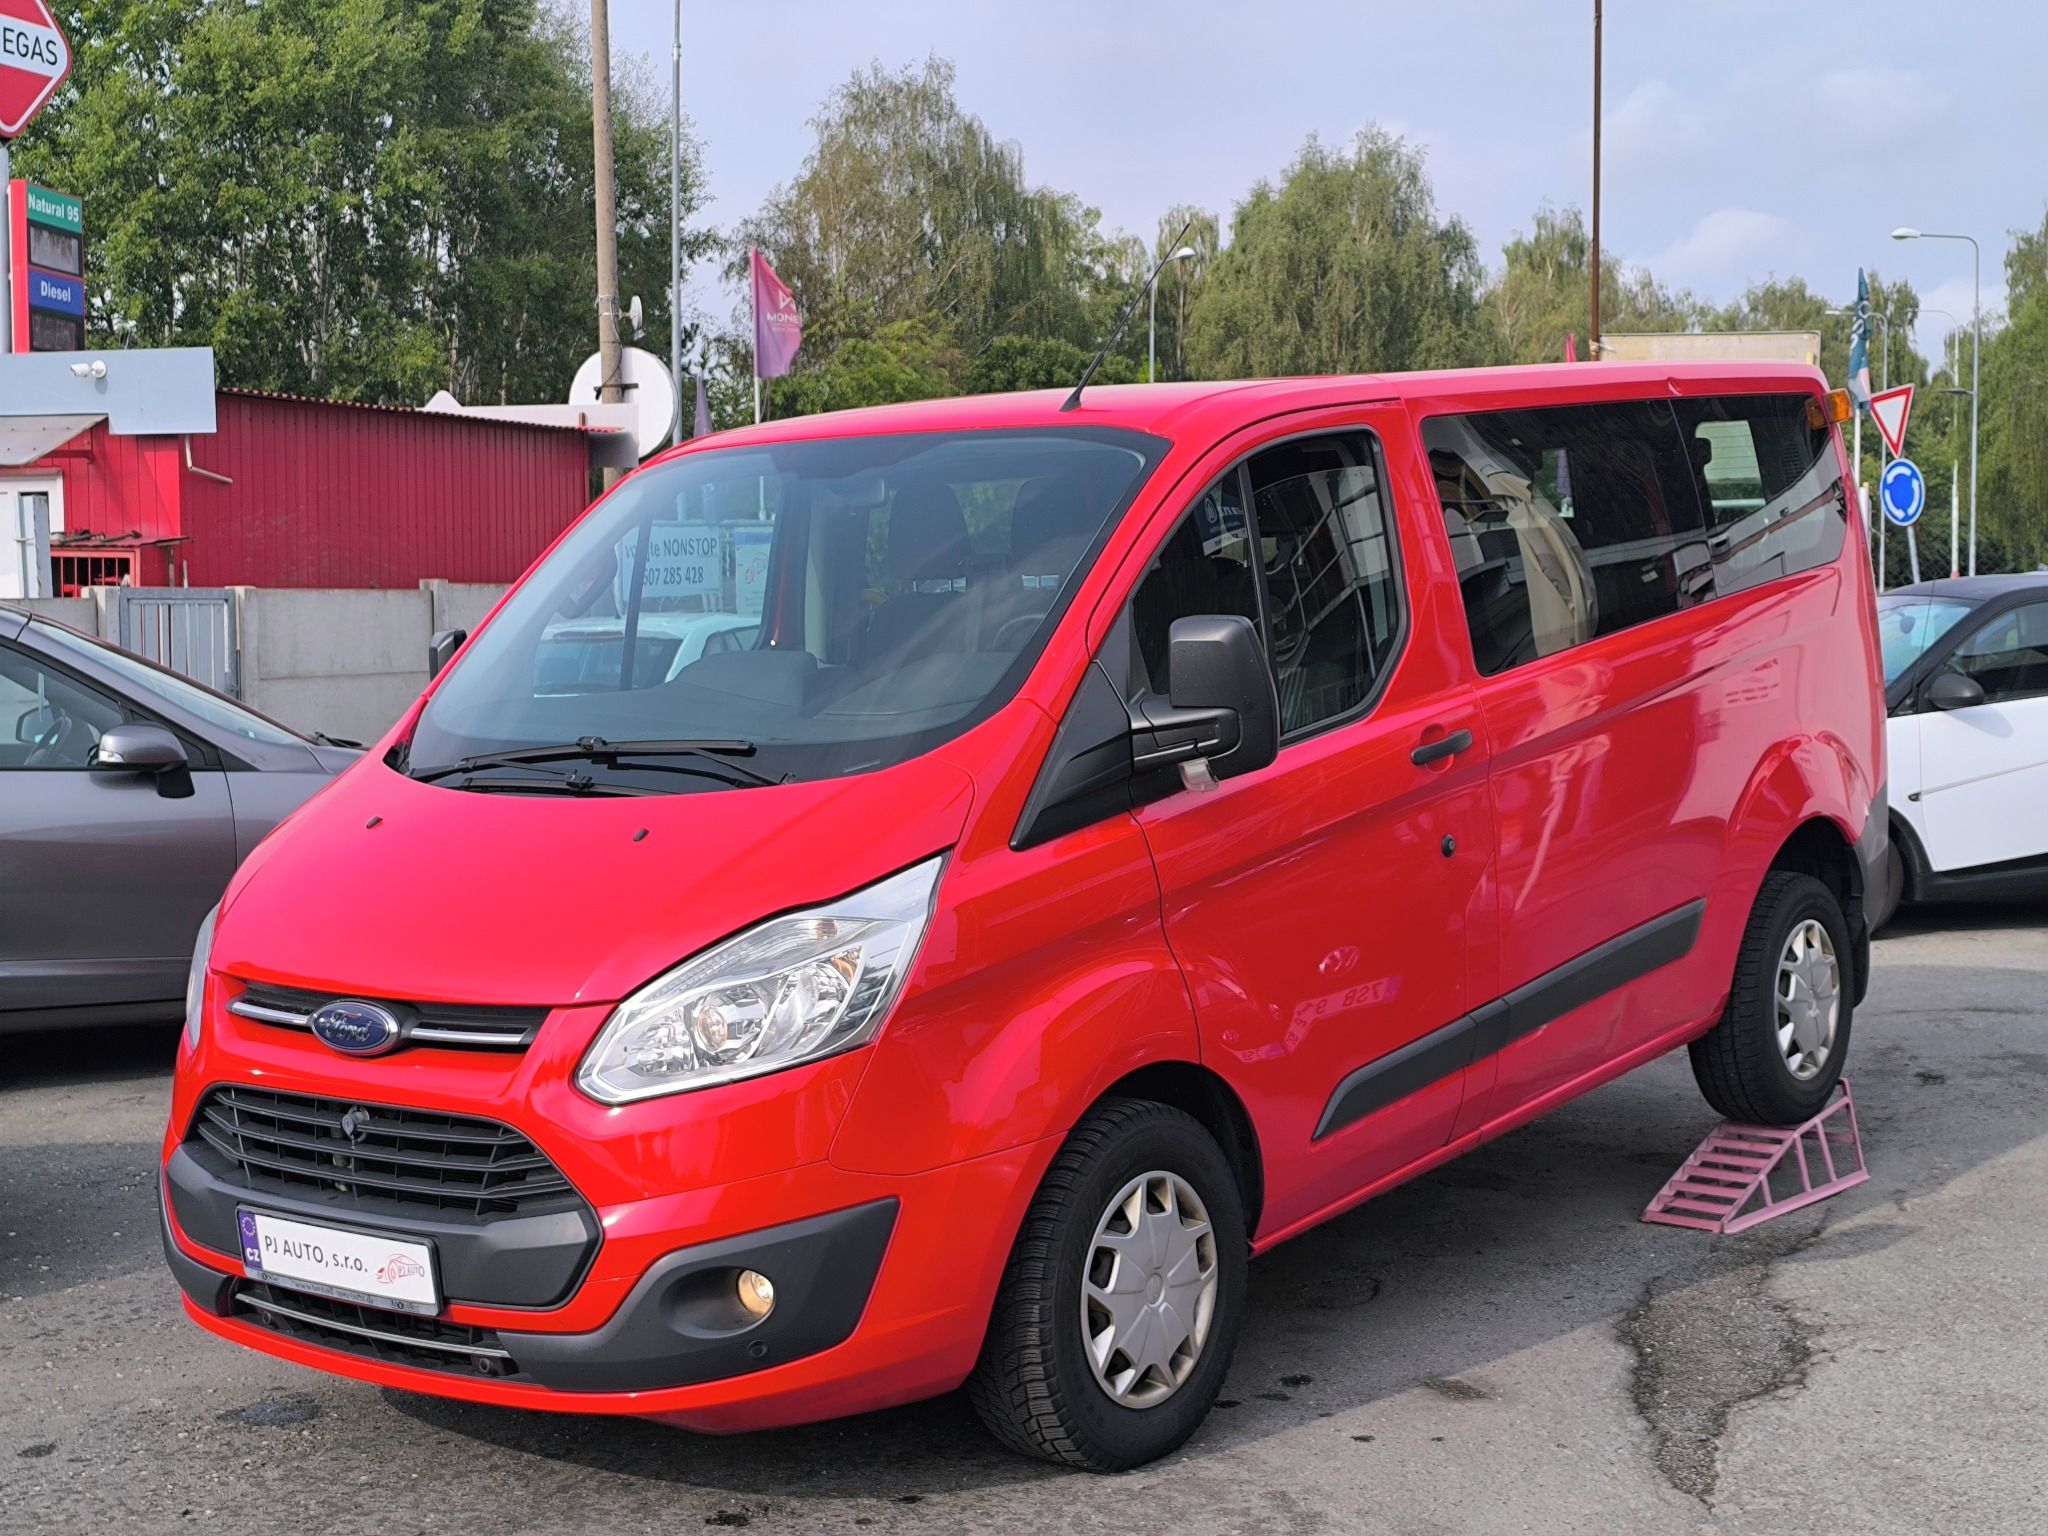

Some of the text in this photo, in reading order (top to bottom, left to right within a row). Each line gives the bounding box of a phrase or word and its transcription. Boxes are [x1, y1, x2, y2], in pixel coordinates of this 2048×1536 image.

[28, 192, 80, 223] Natural 95
[40, 280, 71, 303] Diesel
[663, 537, 717, 557] NONSTOP
[663, 567, 682, 585] 285
[685, 566, 704, 583] 428
[325, 1009, 373, 1040] Ford
[246, 1247, 260, 1262] CZ
[264, 1235, 368, 1273] PJ AUTO, s.r.o.
